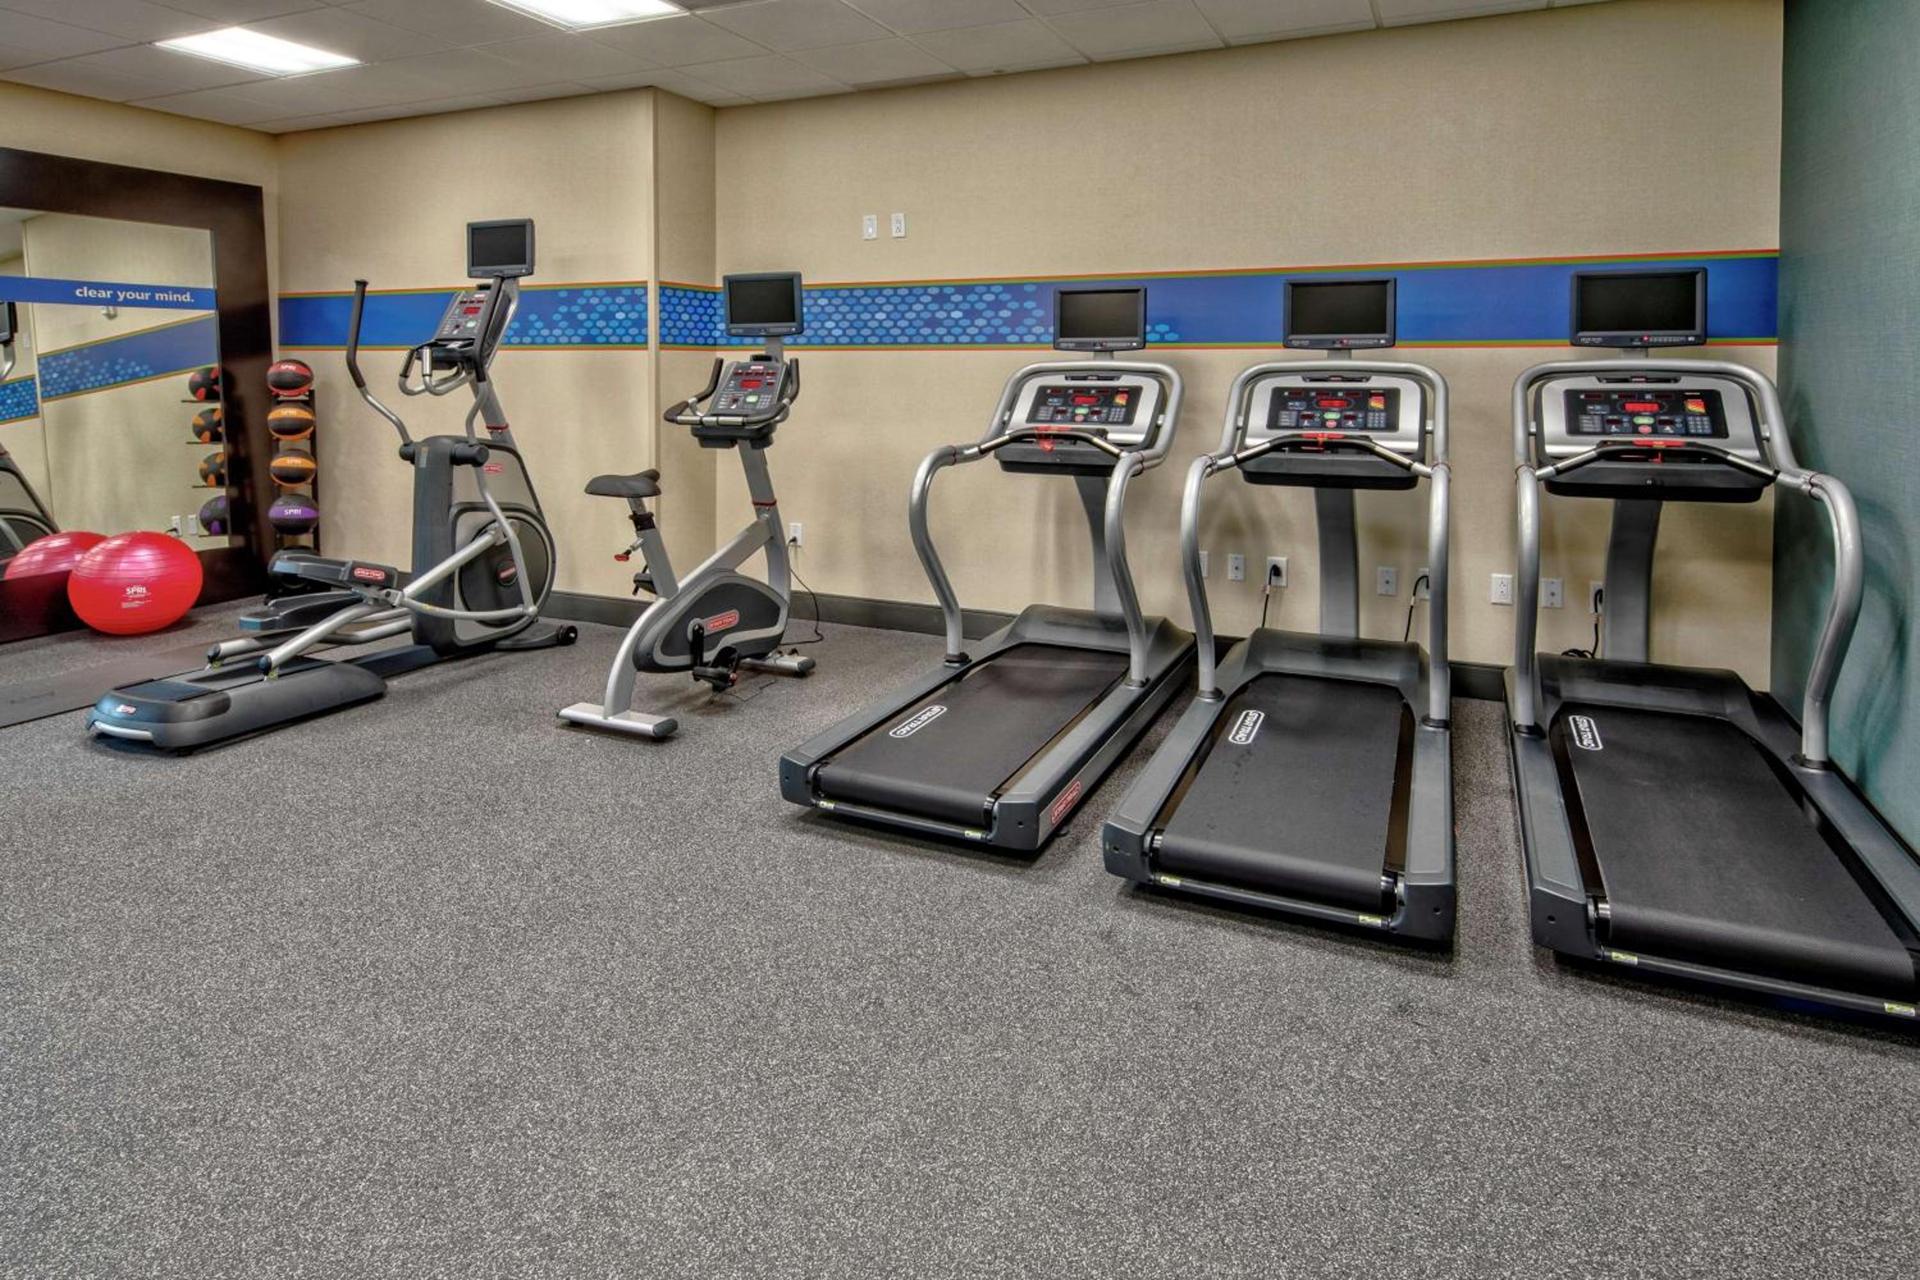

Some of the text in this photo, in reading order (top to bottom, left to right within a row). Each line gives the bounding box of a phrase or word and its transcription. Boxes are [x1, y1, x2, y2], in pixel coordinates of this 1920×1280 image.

[75, 286, 195, 303] clear your mind.
[283, 508, 302, 516] SPRI
[125, 585, 147, 596] SPRI
